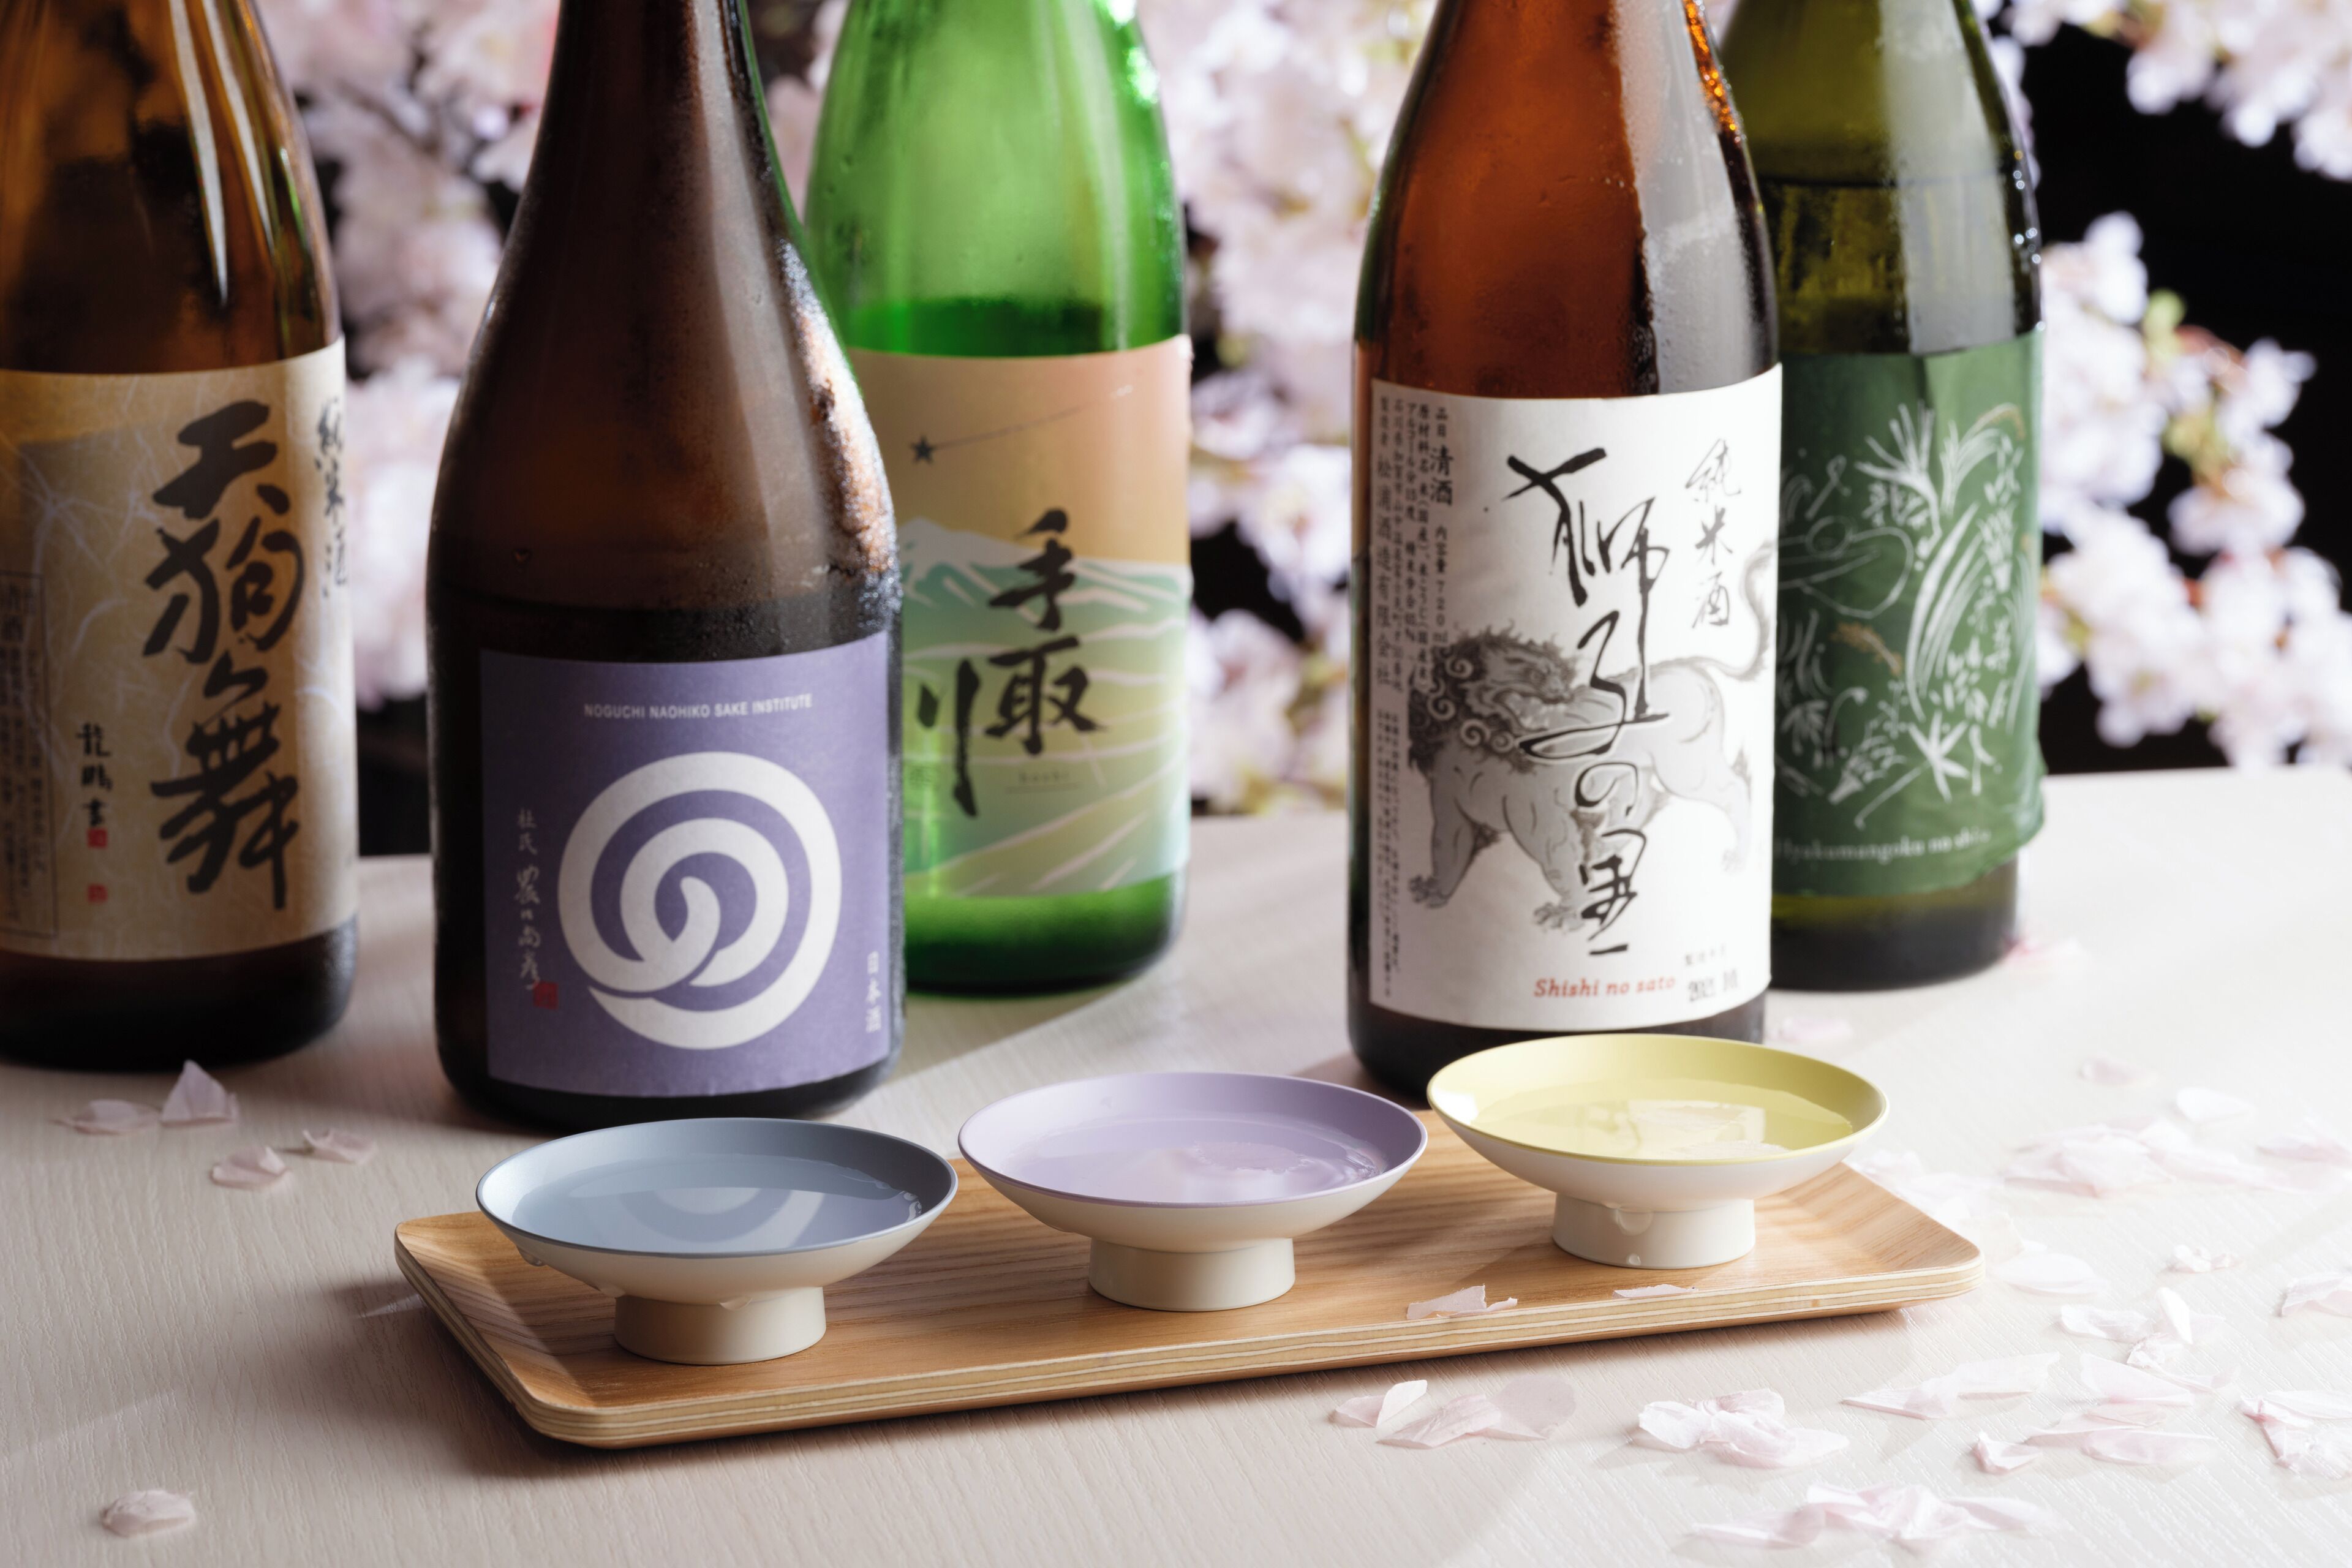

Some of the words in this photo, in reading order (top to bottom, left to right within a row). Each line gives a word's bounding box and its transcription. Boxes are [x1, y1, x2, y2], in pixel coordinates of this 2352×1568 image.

[1430, 445, 1455, 507] 清酒
[142, 399, 304, 911] 天狗舞
[584, 703, 645, 720] NOGUCHI
[649, 704, 710, 720] NAOHIKO
[714, 701, 748, 717] SAKE
[752, 693, 813, 715] INSTITUTE
[1501, 445, 1671, 957] 獅子の里
[1533, 975, 1599, 998] Shishi
[1605, 980, 1630, 995] no
[1637, 975, 1677, 993] sato
